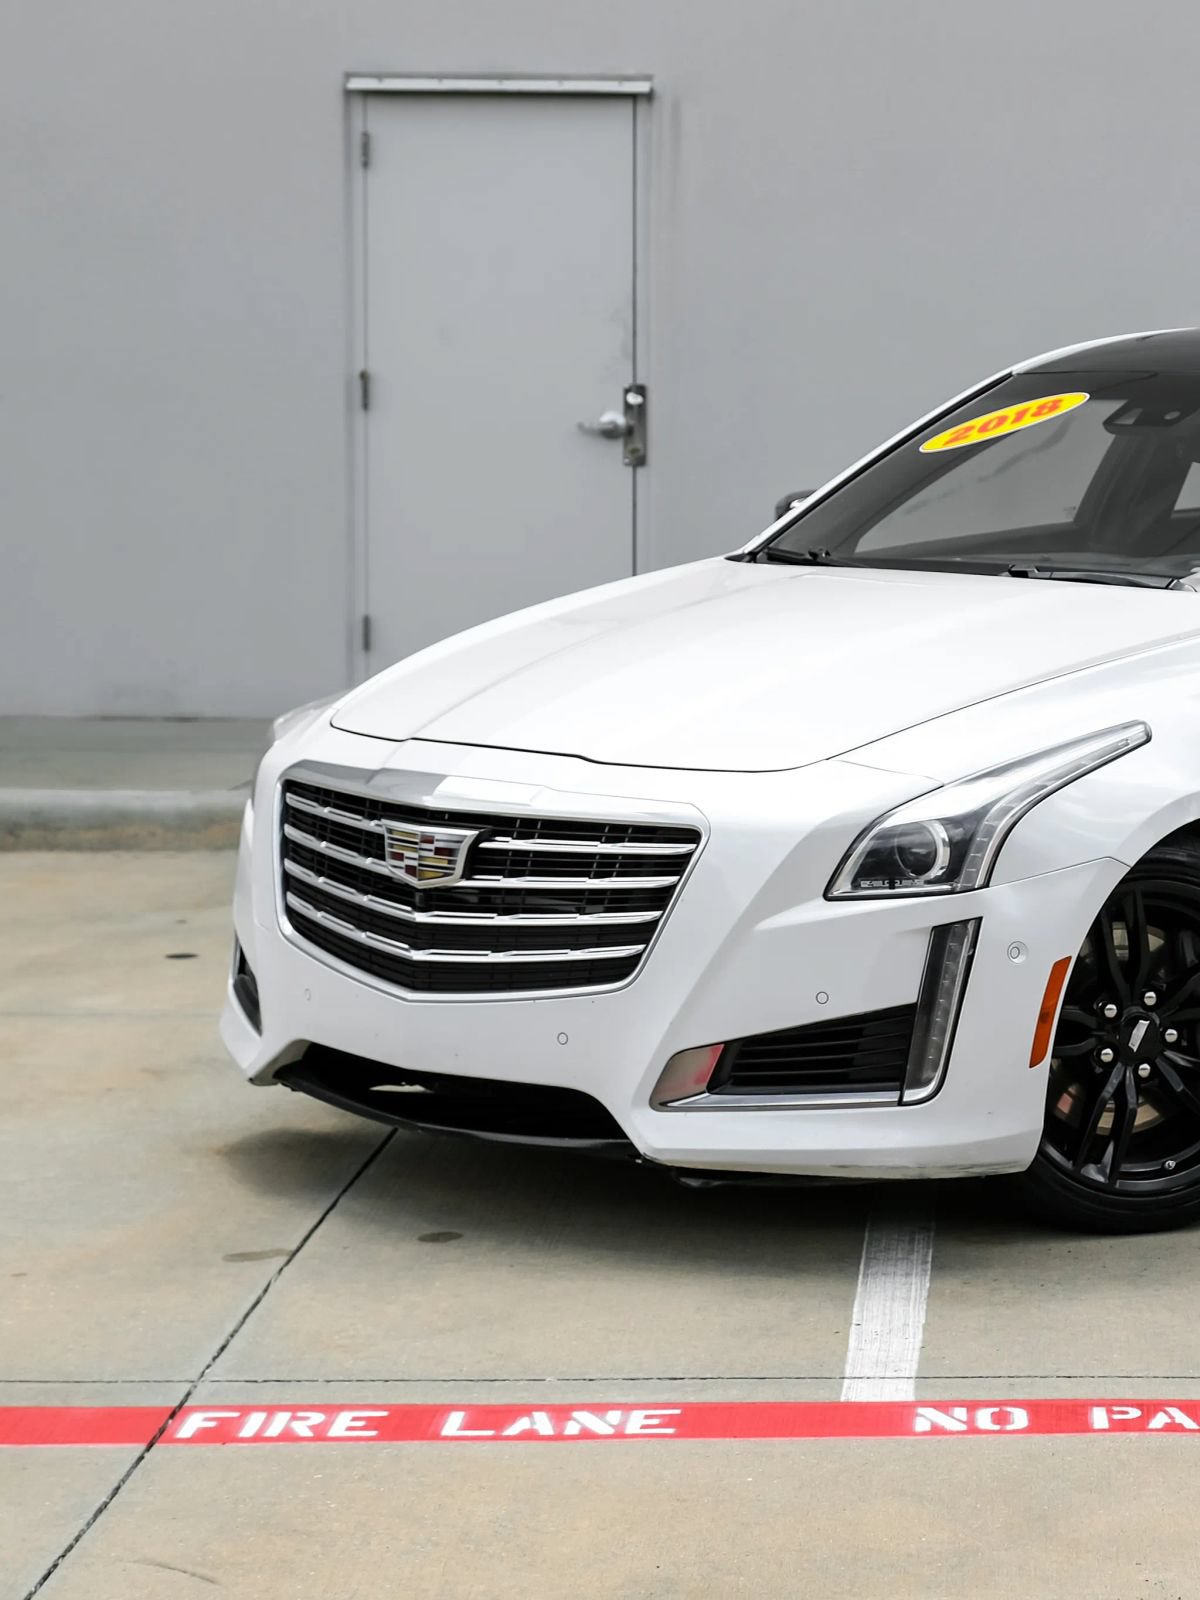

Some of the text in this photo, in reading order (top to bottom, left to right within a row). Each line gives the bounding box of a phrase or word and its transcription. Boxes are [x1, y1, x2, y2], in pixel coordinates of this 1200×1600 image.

[944, 399, 1063, 446] 2018
[175, 1410, 389, 1439] FIRE
[440, 1408, 682, 1437] LANE
[913, 1406, 1029, 1432] NO
